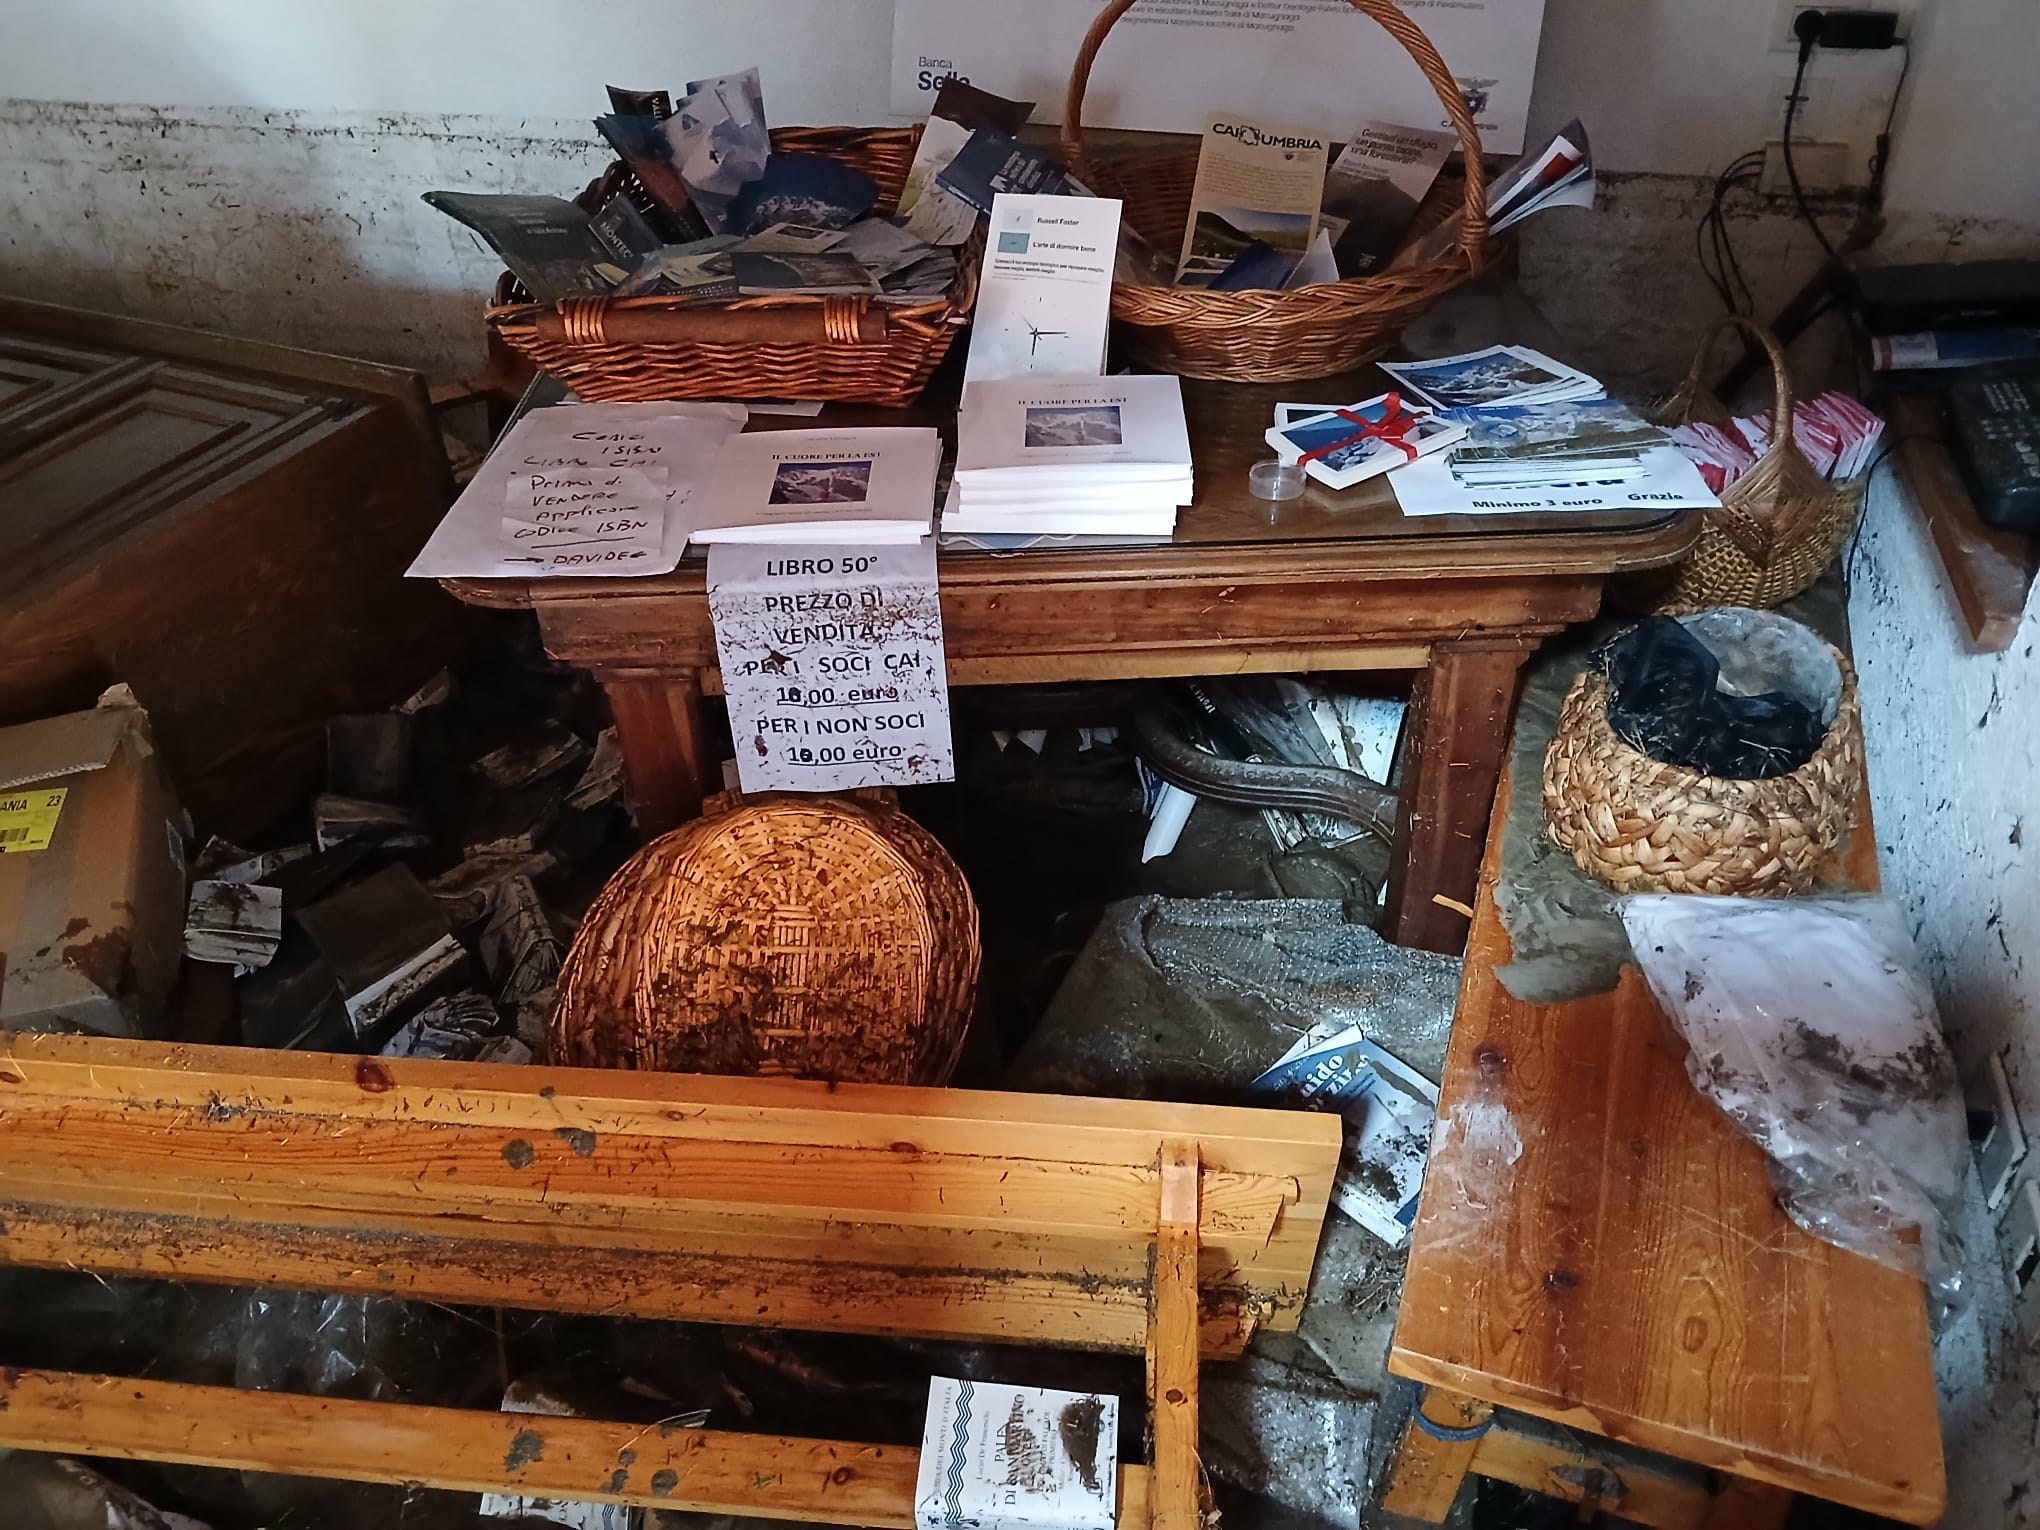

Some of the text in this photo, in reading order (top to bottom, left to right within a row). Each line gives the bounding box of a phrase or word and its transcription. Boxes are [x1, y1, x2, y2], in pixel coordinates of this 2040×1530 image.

[919, 57, 952, 69] Banca
[1212, 123, 1322, 150] CAI UMBRIA
[1037, 217, 1080, 226] Russell Foster
[1472, 500, 1541, 508] Minimo
[1562, 498, 1603, 507] euro
[597, 519, 648, 533] ISBN
[766, 556, 878, 577] LIBRO 50°
[765, 590, 884, 613] PREZZO DI
[774, 624, 875, 645] VENDITA
[793, 660, 800, 674] I
[818, 656, 871, 673] SOCI
[884, 652, 921, 670] CAI
[849, 687, 899, 701] euro
[757, 714, 925, 735] PER I NON SOCI
[853, 745, 901, 760] euro
[47, 795, 61, 807] 23
[938, 1425, 947, 1453] MONTI
[994, 1430, 1006, 1462] PALE
[1004, 1490, 1017, 1505] DI
